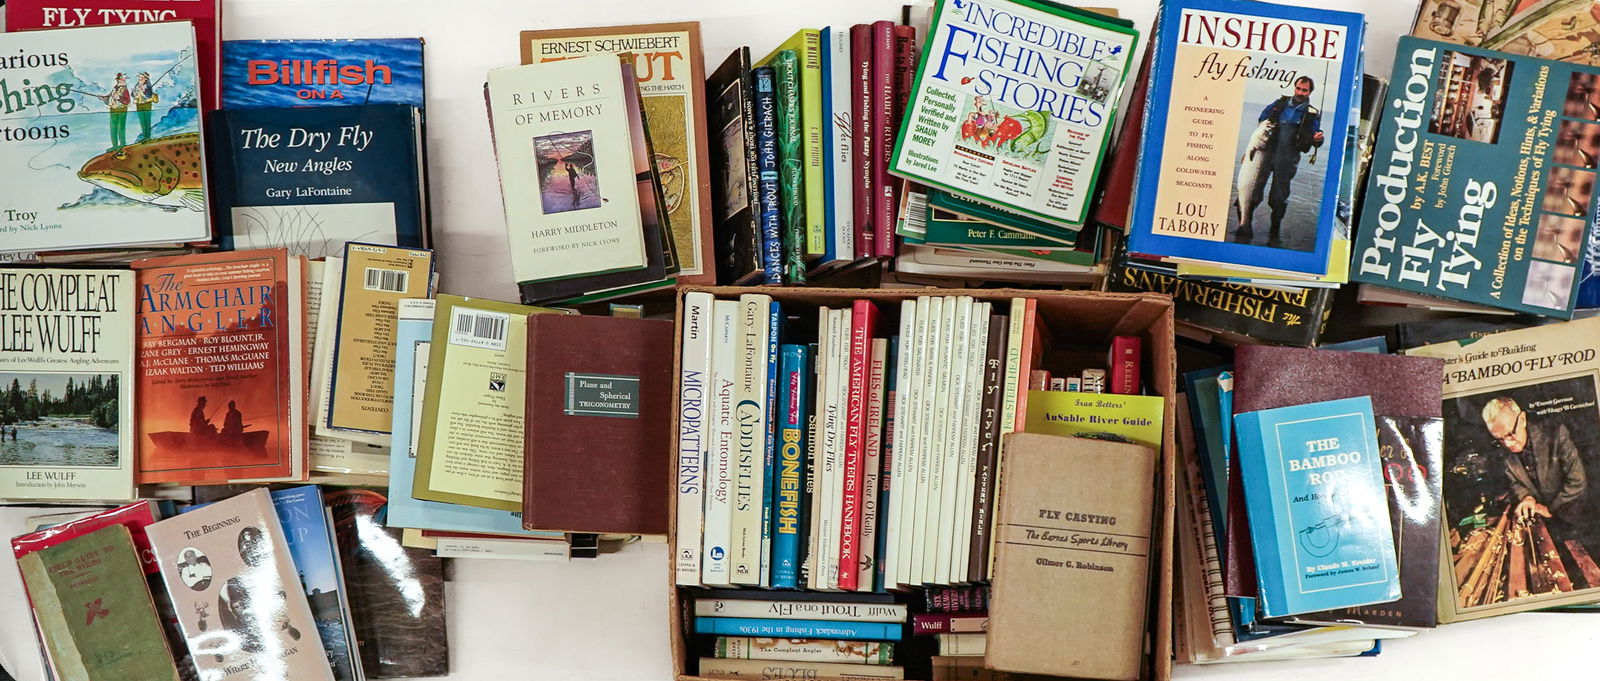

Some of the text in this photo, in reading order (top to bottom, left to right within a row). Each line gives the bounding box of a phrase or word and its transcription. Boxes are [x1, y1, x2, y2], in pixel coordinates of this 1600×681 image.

[42, 7, 91, 27] FLY
[964, 1, 1106, 61] INCREDIBLE
[1180, 13, 1340, 60] INSHORE
[541, 36, 680, 54] ERNEST SCHWIEBERT
[931, 23, 1083, 88] FISHING
[247, 60, 392, 85] Billfish
[1194, 52, 1298, 88] fly fishing
[296, 89, 344, 99] ON A
[512, 83, 602, 105] RIVERS
[884, 85, 892, 118] HABIT
[974, 69, 1105, 127] STORIES
[515, 104, 602, 126] OF MEMORY
[921, 105, 957, 122] Verified and
[1184, 106, 1225, 115] PIONEERING
[762, 97, 776, 168] JOHN GIERACH
[915, 124, 938, 137] SHAUN
[918, 115, 950, 132] Written by
[1192, 118, 1214, 126] GUIDE
[241, 125, 373, 153] The Dry Fly
[884, 126, 892, 162] RIVERS
[912, 134, 937, 147] MOREY
[1186, 142, 1214, 150] FISHING
[264, 157, 353, 175] New Angles
[1186, 155, 1210, 163] ALONG
[1360, 47, 1437, 280] Production
[1431, 143, 1447, 181] Foreword
[1176, 180, 1213, 190] SEACOASTS
[1435, 145, 1457, 209] by John Gierach
[1490, 65, 1549, 300] A Collection of Ideas, Notions, Hints, & Variations
[1513, 109, 1557, 262] on the Techniques of Fly Tying
[266, 186, 352, 199] Gary LaFontaine
[5, 210, 38, 223] Troy
[1176, 202, 1208, 218] LOU
[531, 220, 618, 238] HARRY MIDDLETON
[767, 182, 781, 282] DANCES WITH TROUT
[968, 228, 1036, 240] Peter F. Cammann
[1159, 216, 1219, 236] TABORY
[1436, 178, 1498, 291] Tying
[1398, 217, 1446, 288] Fly
[21, 273, 120, 312] COMPLEAT
[136, 285, 273, 314] ARMCHAIR
[690, 305, 701, 340] Martin
[0, 315, 101, 353] LEE WULFF
[852, 327, 864, 355] THE
[161, 348, 183, 357] GREY
[188, 346, 218, 355] ERNEST
[218, 343, 270, 353] HEMINGWAY
[743, 301, 758, 393] Gary LaFontaine
[145, 361, 264, 376] IZAAK WALTON TED WILLIAMS
[195, 354, 230, 364] THOMAS
[231, 352, 270, 361] McGUANE
[1452, 361, 1523, 383] BAMBOO
[1524, 355, 1557, 371] FLY
[1558, 348, 1596, 365] ROD
[987, 359, 1000, 394] Fly
[600, 391, 631, 401] Spherical
[850, 359, 864, 422] AMERICAN
[579, 401, 631, 409] TRIGONOMETRY
[867, 359, 882, 457] FLIES of IRELAND
[1075, 399, 1127, 409] Fran Betters'
[1045, 412, 1152, 426] AuSable River Guide
[680, 369, 703, 495] MICROPATTERNS
[715, 378, 735, 504] Aquatic Entomology
[824, 404, 837, 472] Tying Dry Flies
[848, 425, 859, 448] FLY
[735, 399, 761, 512] CADDISFLIES
[1306, 437, 1340, 453] THE
[1288, 451, 1361, 472] BAMBOO
[26, 471, 76, 480] LEE WULFF
[778, 428, 802, 534] BONEFISH
[841, 494, 855, 560] HANDBOOK
[1039, 509, 1116, 526] FLY CASTING
[1036, 557, 1114, 572] Gilmer G. Robinson
[769, 601, 793, 613] Fly
[822, 603, 861, 617] Trout
[868, 607, 897, 617] Wulff
[739, 625, 759, 634] 1930s
[785, 626, 813, 635] Fishing
[816, 628, 857, 637] Adirondack
[921, 621, 943, 630] Wulff
